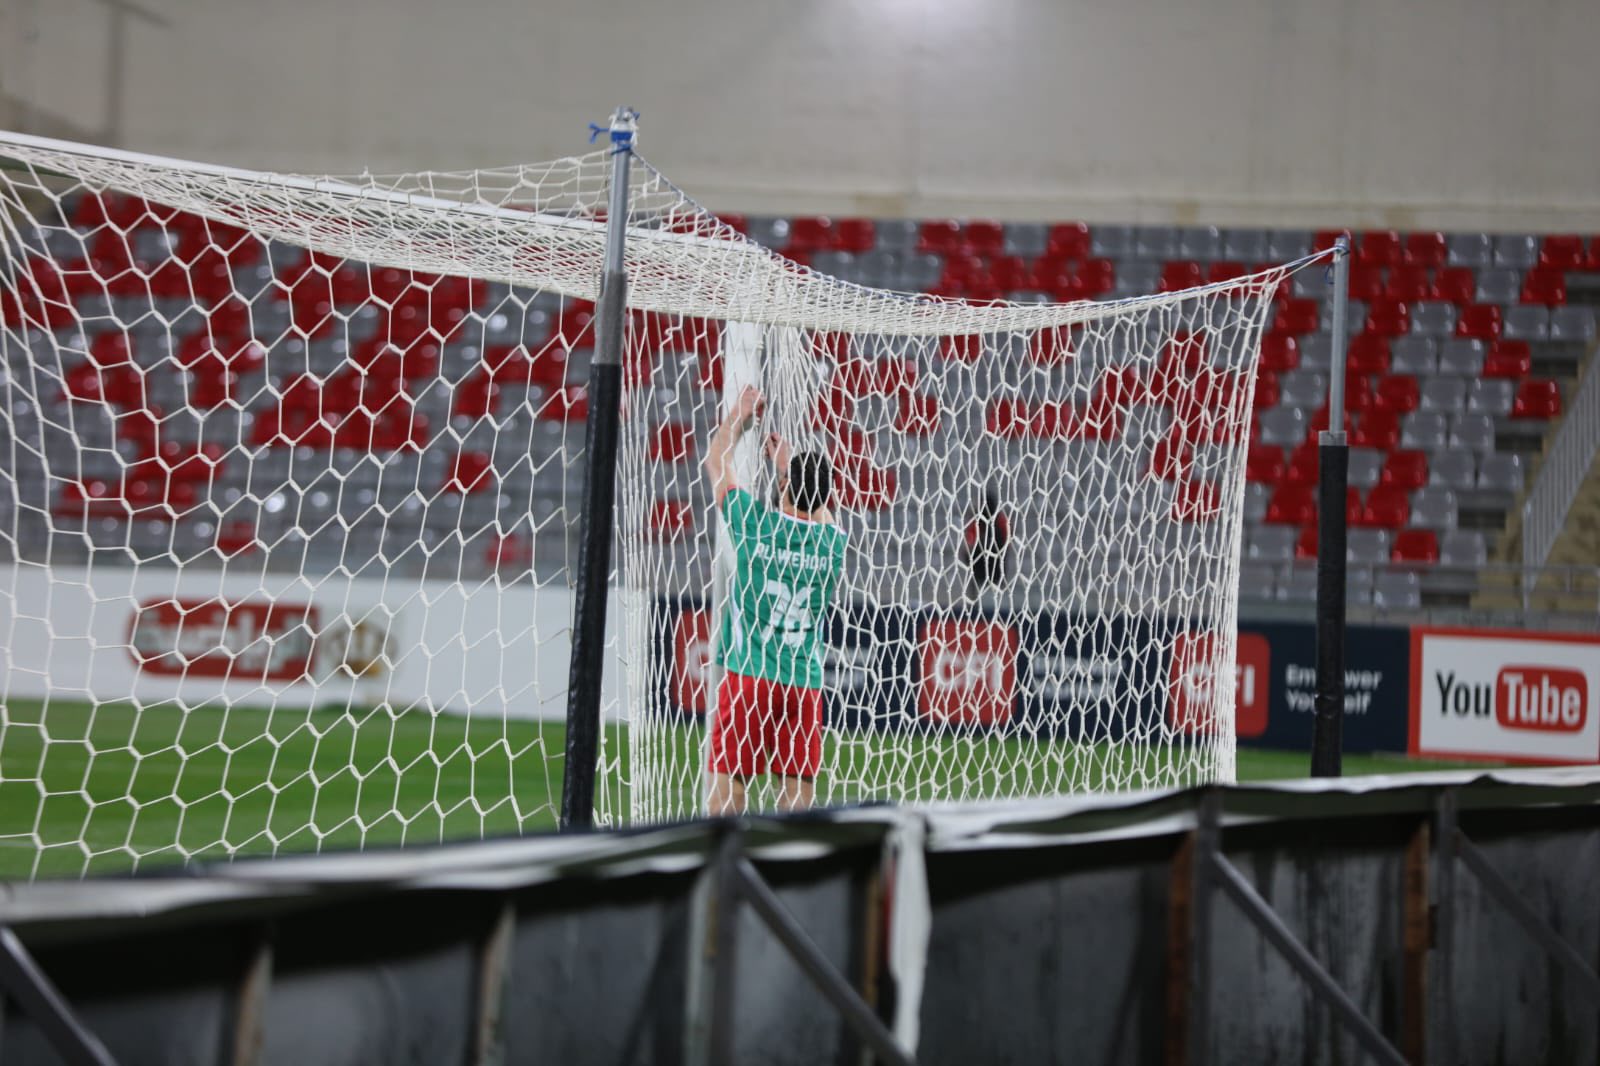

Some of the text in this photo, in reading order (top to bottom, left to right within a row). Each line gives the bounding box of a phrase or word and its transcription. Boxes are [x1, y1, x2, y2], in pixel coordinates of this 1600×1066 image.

[932, 650, 1003, 694] CFI
[1183, 663, 1256, 707] CI
[1285, 663, 1383, 691] Emwer
[1285, 688, 1372, 715] Yoelf
